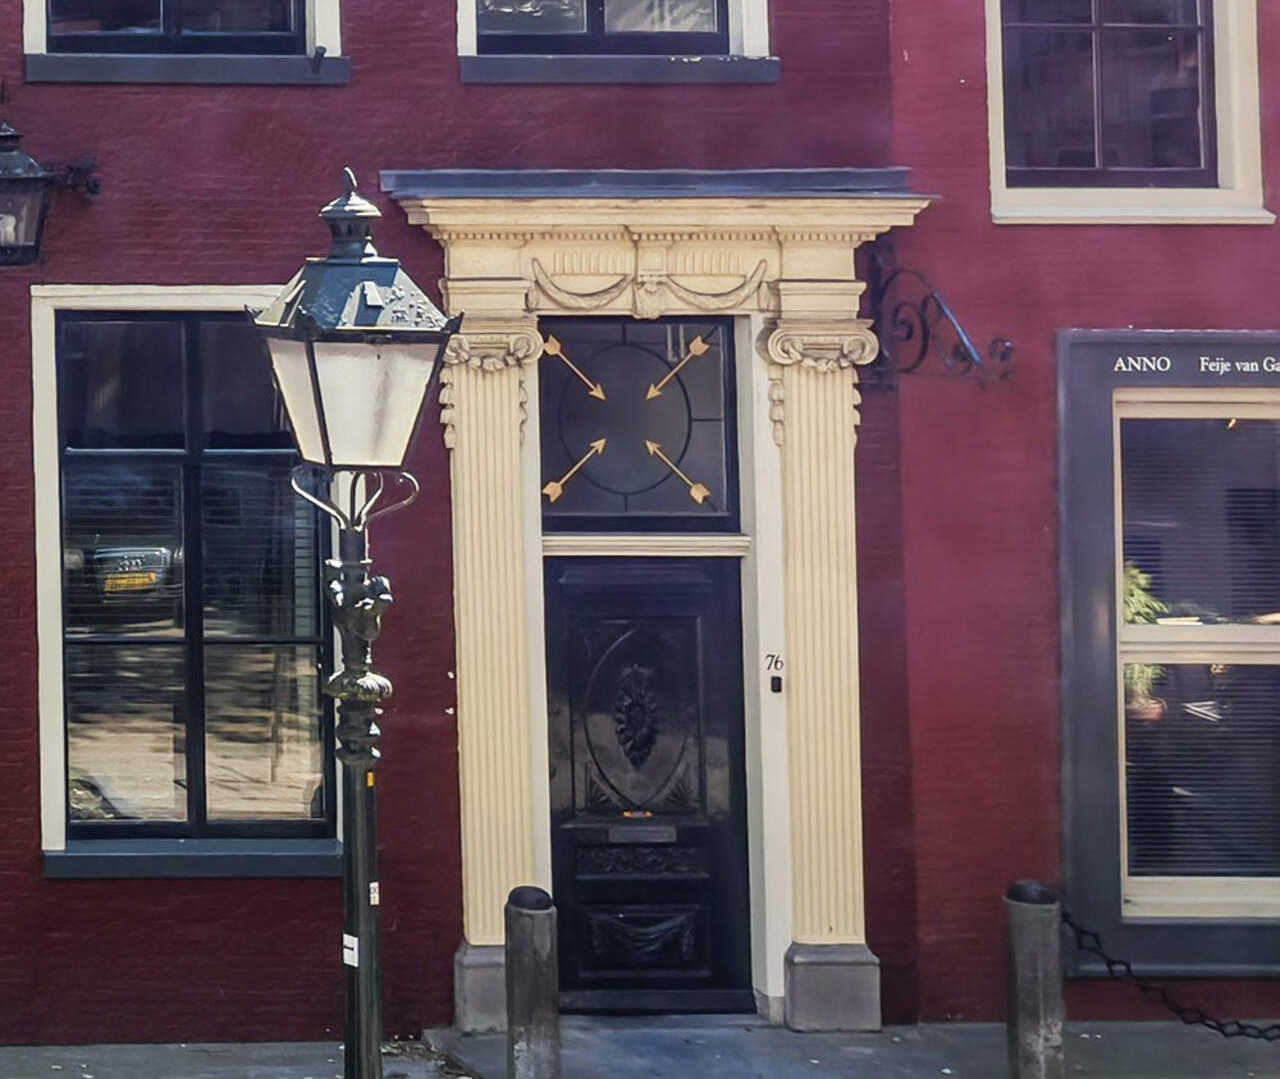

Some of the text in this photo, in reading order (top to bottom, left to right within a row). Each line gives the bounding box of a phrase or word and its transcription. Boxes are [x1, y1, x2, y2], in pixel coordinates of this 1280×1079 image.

[1113, 356, 1172, 373] ANNO
[1199, 356, 1232, 376] Feije
[1235, 361, 1260, 373] van
[765, 653, 784, 671] 76
